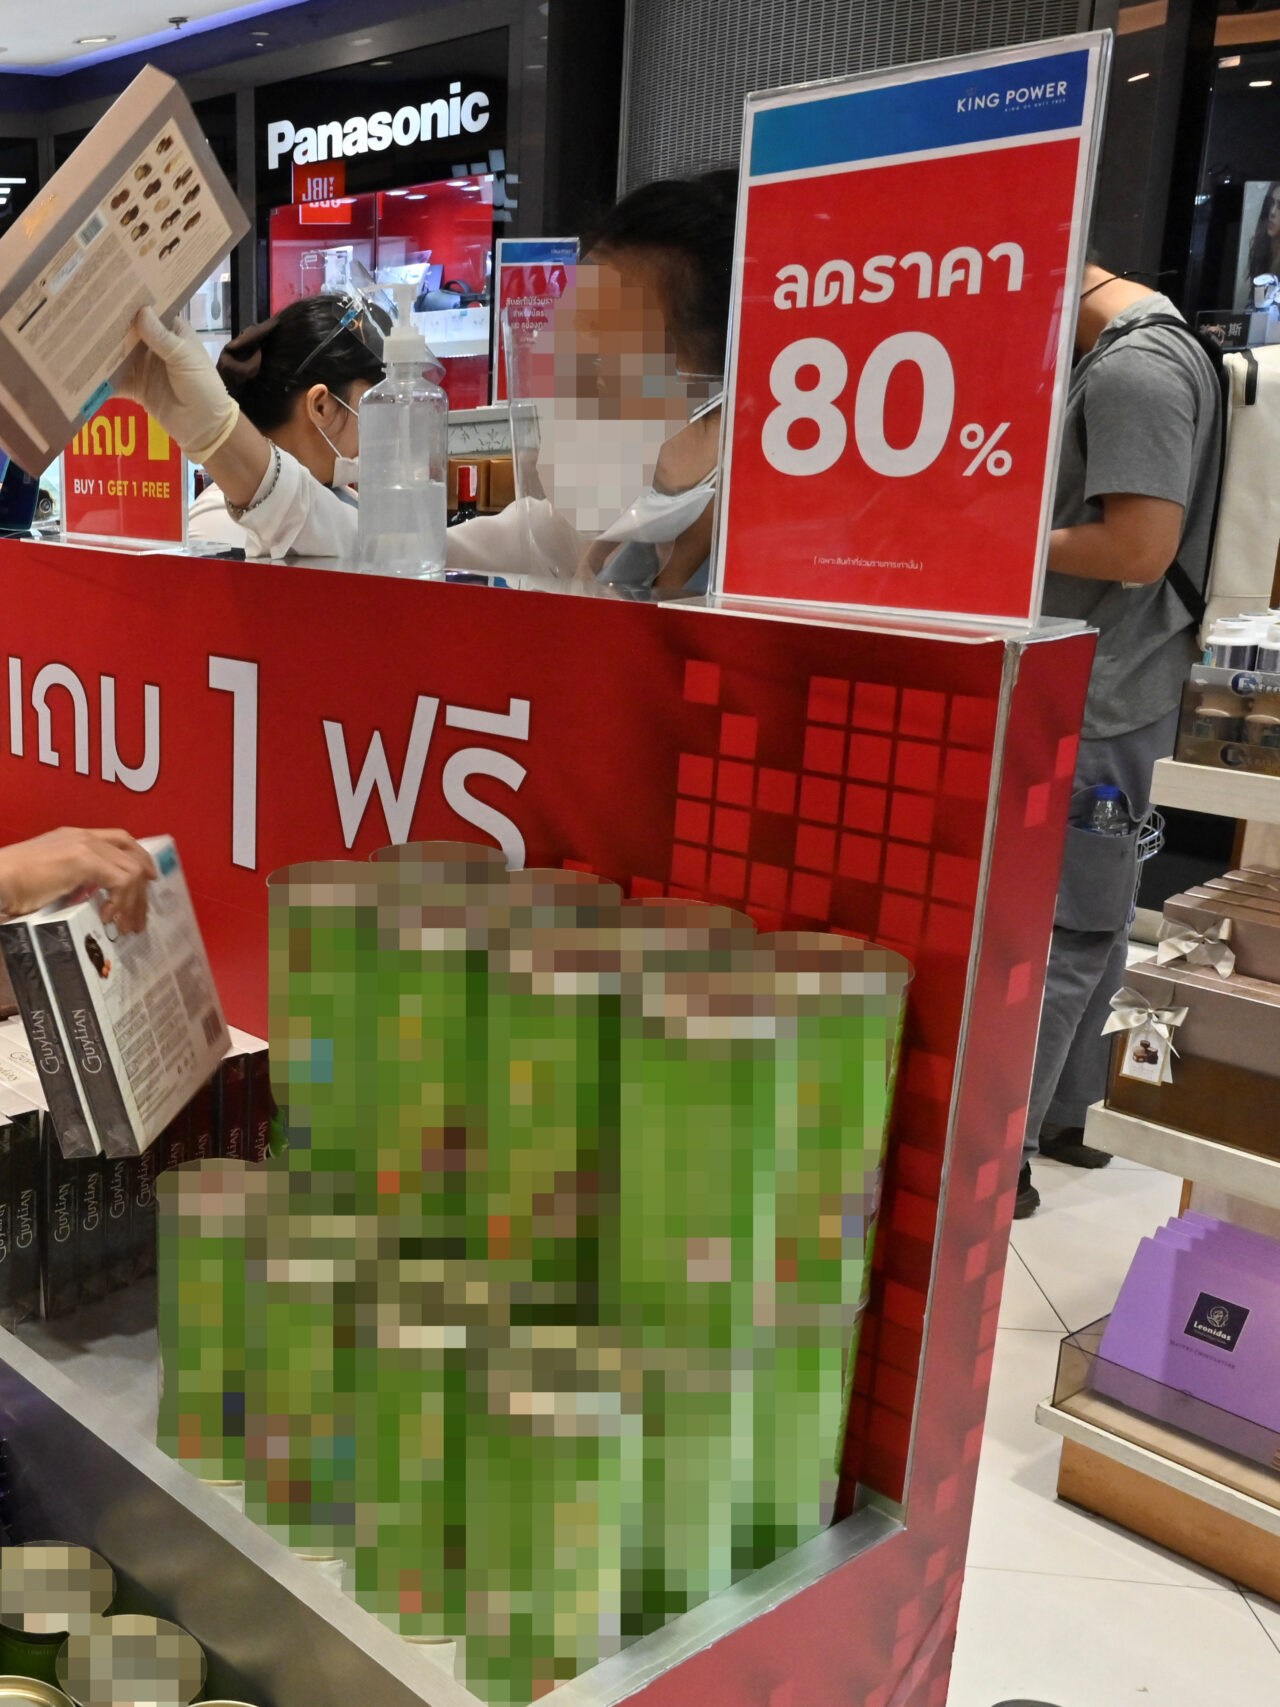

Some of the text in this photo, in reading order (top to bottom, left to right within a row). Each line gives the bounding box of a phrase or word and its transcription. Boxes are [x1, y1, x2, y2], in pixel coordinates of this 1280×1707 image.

[957, 81, 1068, 113] KING POWER
[268, 81, 490, 170] Panasonic
[773, 241, 1024, 311] ลดราคา
[73, 479, 170, 498] BUY 1 GET 1 FREE
[209, 655, 258, 870] 1
[322, 694, 531, 872] ฟรี
[1193, 1320, 1232, 1341] Leonidas
